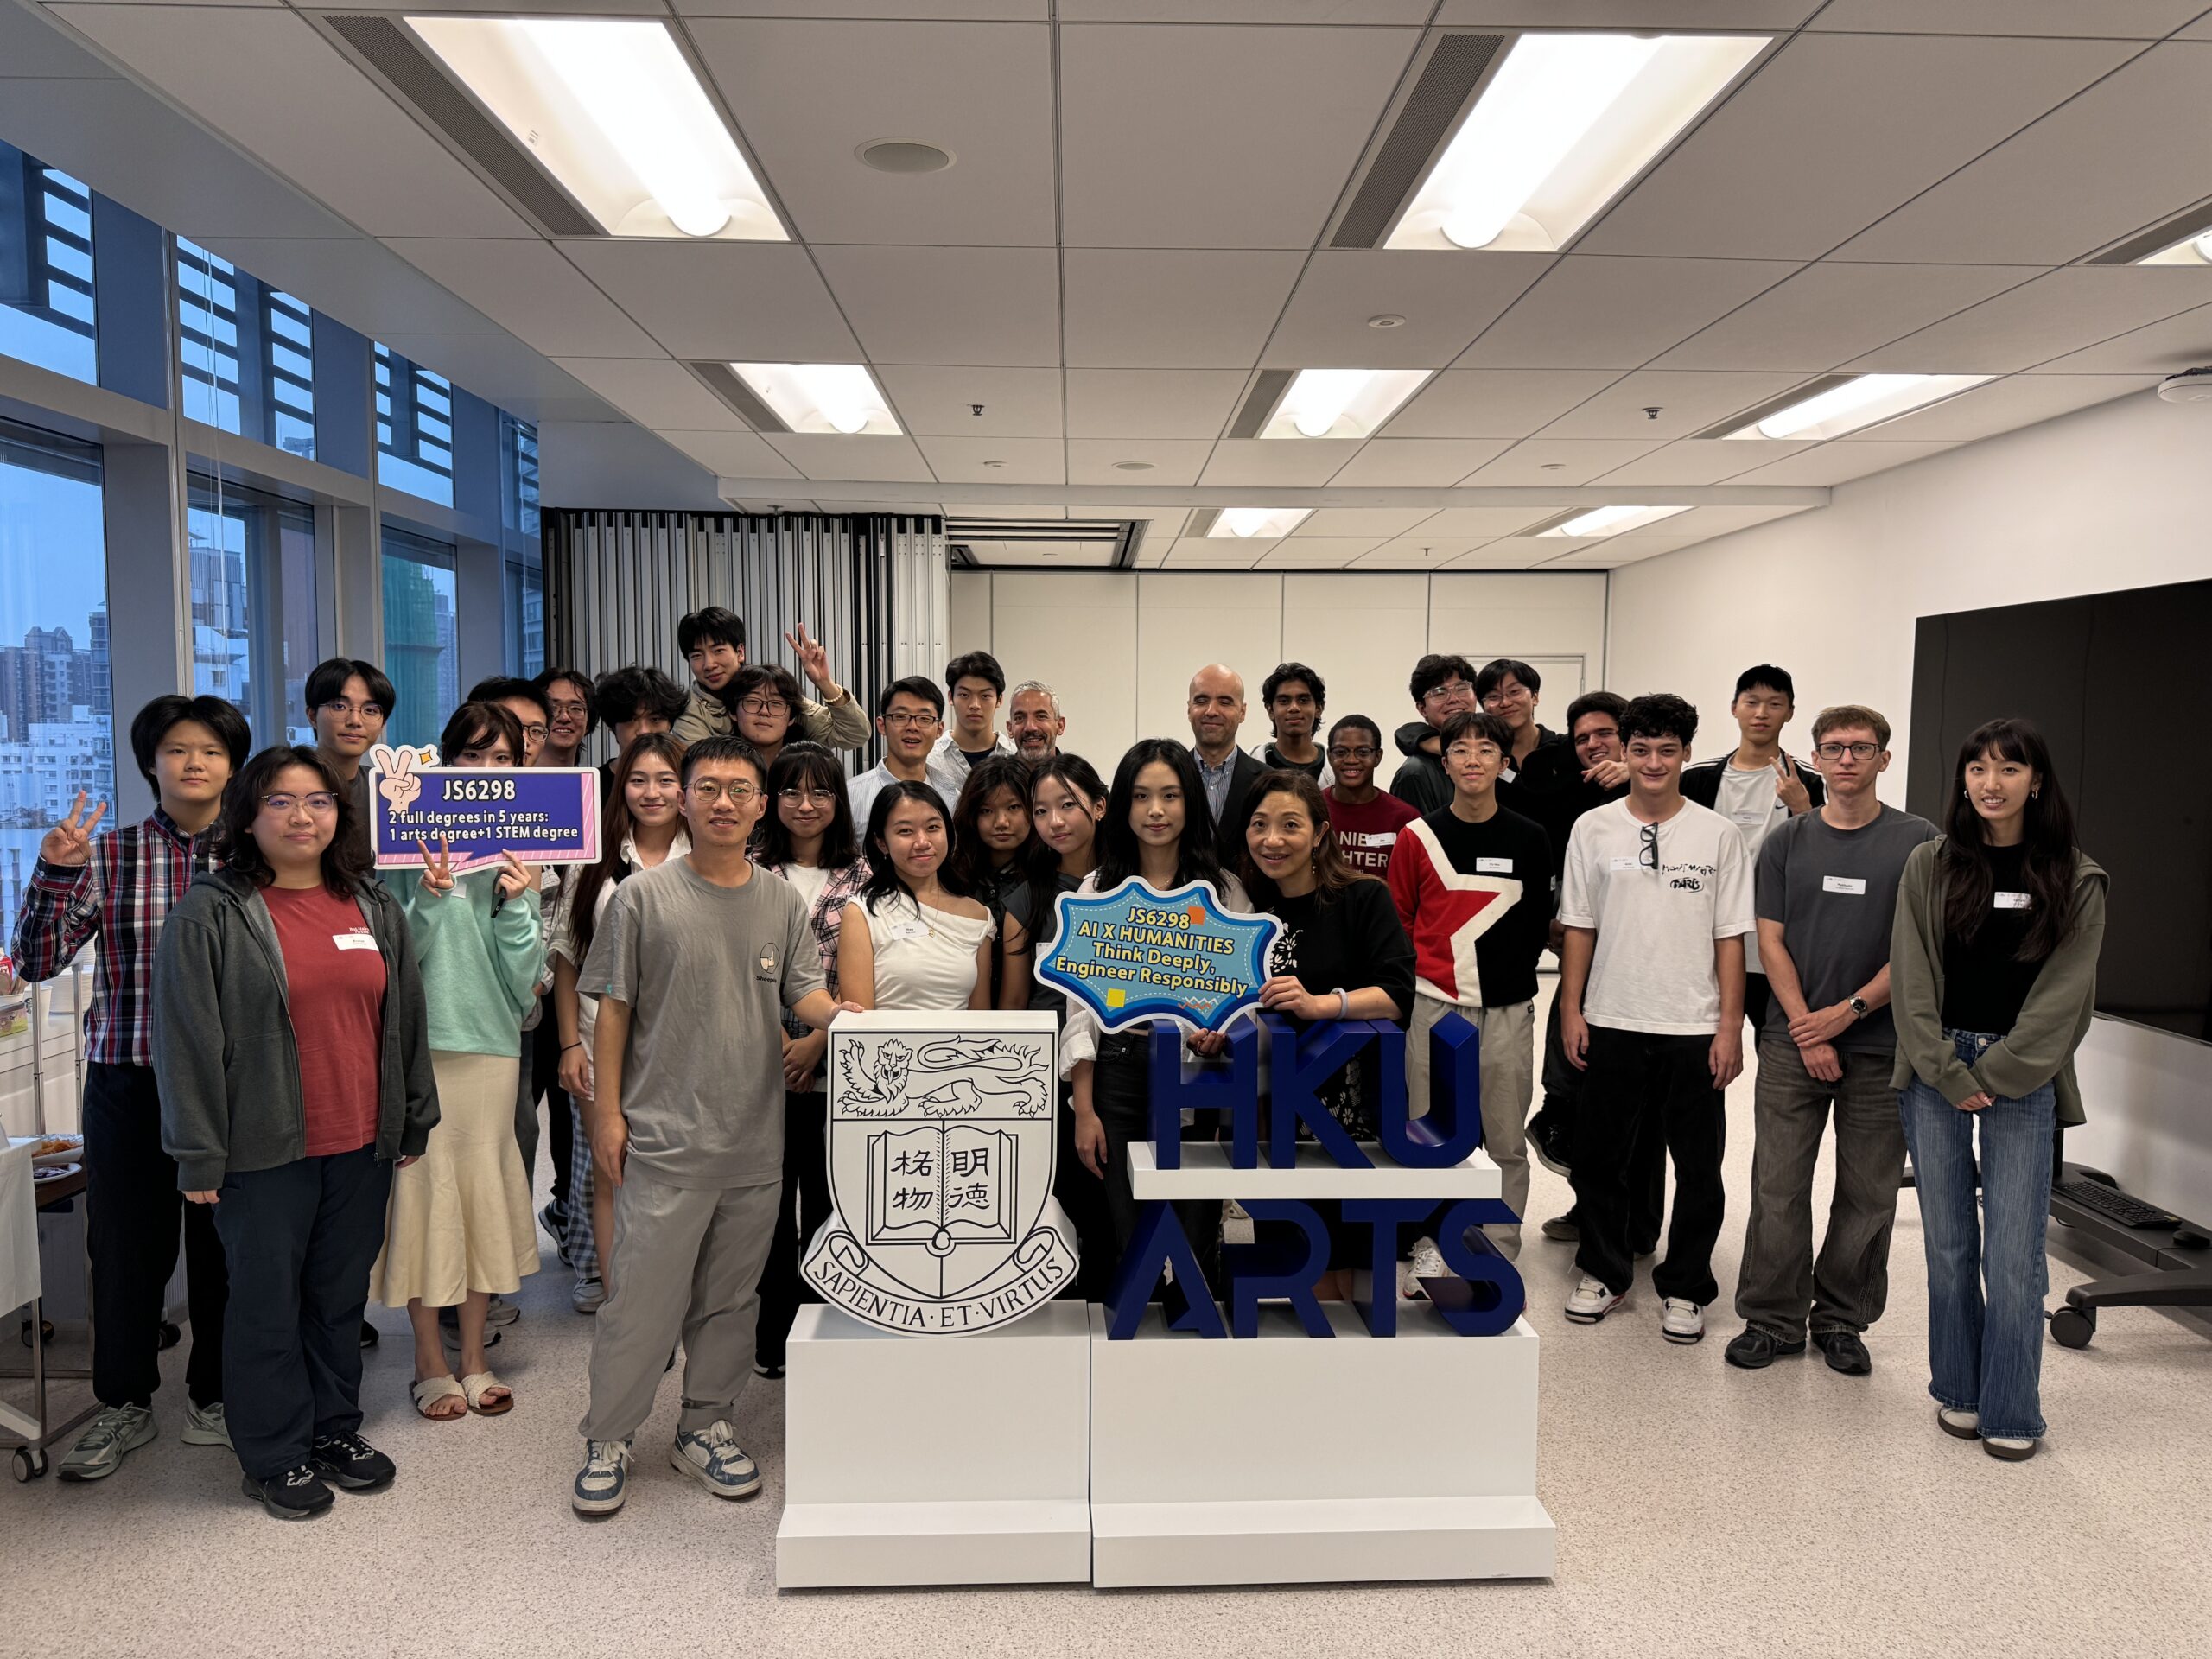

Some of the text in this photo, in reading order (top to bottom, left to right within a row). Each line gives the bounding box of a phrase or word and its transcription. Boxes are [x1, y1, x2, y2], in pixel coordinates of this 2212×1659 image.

[442, 779, 516, 801] JS6298
[389, 810, 549, 827] 2 full degrees in 5 years:
[390, 829, 396, 841] 1
[400, 829, 427, 841] arts
[495, 826, 531, 839] STEM
[533, 825, 578, 841] degree
[1127, 907, 1191, 930] JS6298
[1078, 921, 1235, 955] AI X HUMANITIES
[1092, 941, 1216, 975] Think Deeply,
[1055, 956, 1249, 998] Engineer Responsibly
[1149, 1011, 1482, 1170] HKU
[1108, 1198, 1526, 1341] ARTS
[814, 1256, 1064, 1328] SAPIENTIA ET VIRTUS
